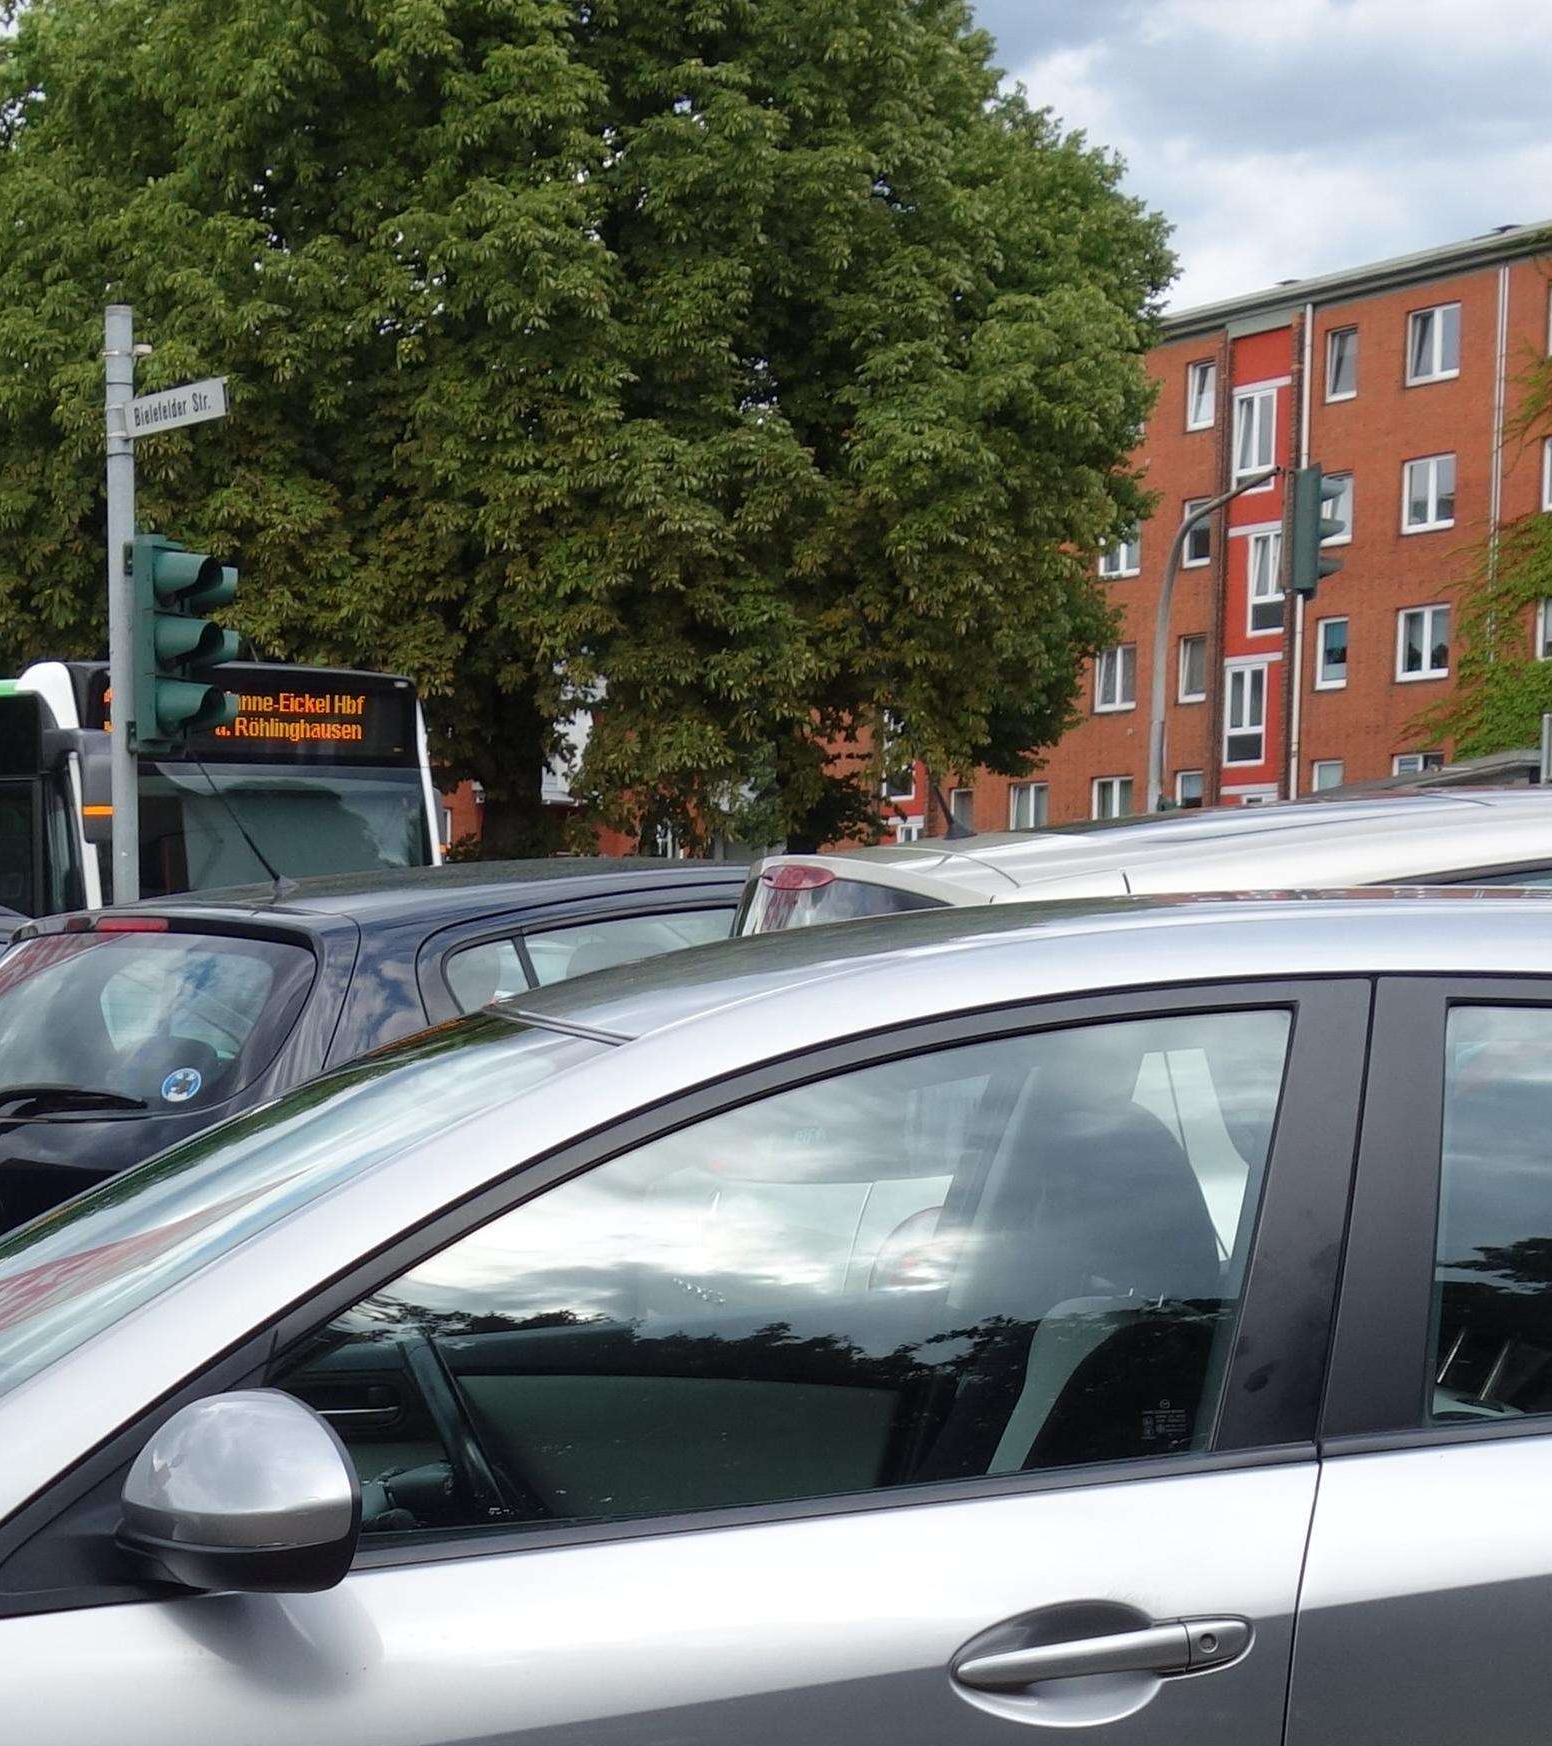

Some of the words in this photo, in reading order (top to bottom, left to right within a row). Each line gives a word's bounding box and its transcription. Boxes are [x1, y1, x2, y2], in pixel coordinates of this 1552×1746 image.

[133, 399, 187, 428] Bielefelder
[191, 391, 212, 413] Str.
[238, 691, 331, 714] nne-Eickel
[333, 693, 366, 715] Hbf
[234, 716, 363, 742] Röhlinghausen
